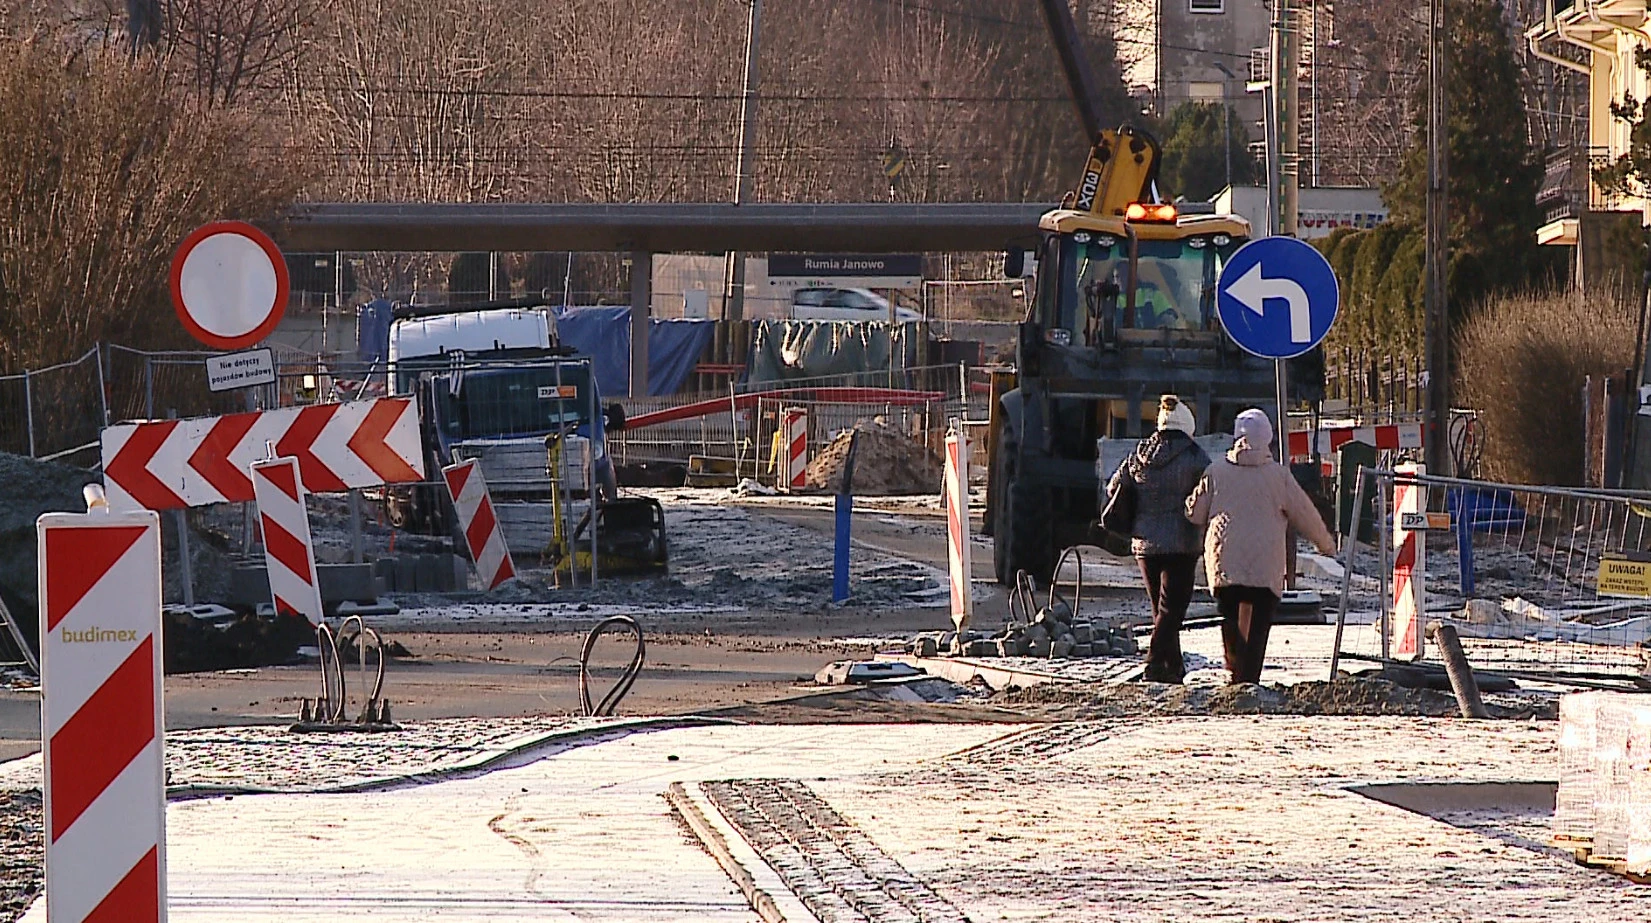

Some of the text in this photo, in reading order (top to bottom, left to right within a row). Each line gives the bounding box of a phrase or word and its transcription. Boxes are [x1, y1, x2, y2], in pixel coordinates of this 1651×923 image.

[805, 258, 884, 269] Rumia Janowo
[234, 358, 259, 368] dotyczy
[245, 368, 271, 378] budowy
[1608, 564, 1646, 576] UWAGA!
[62, 625, 137, 643] budimex
